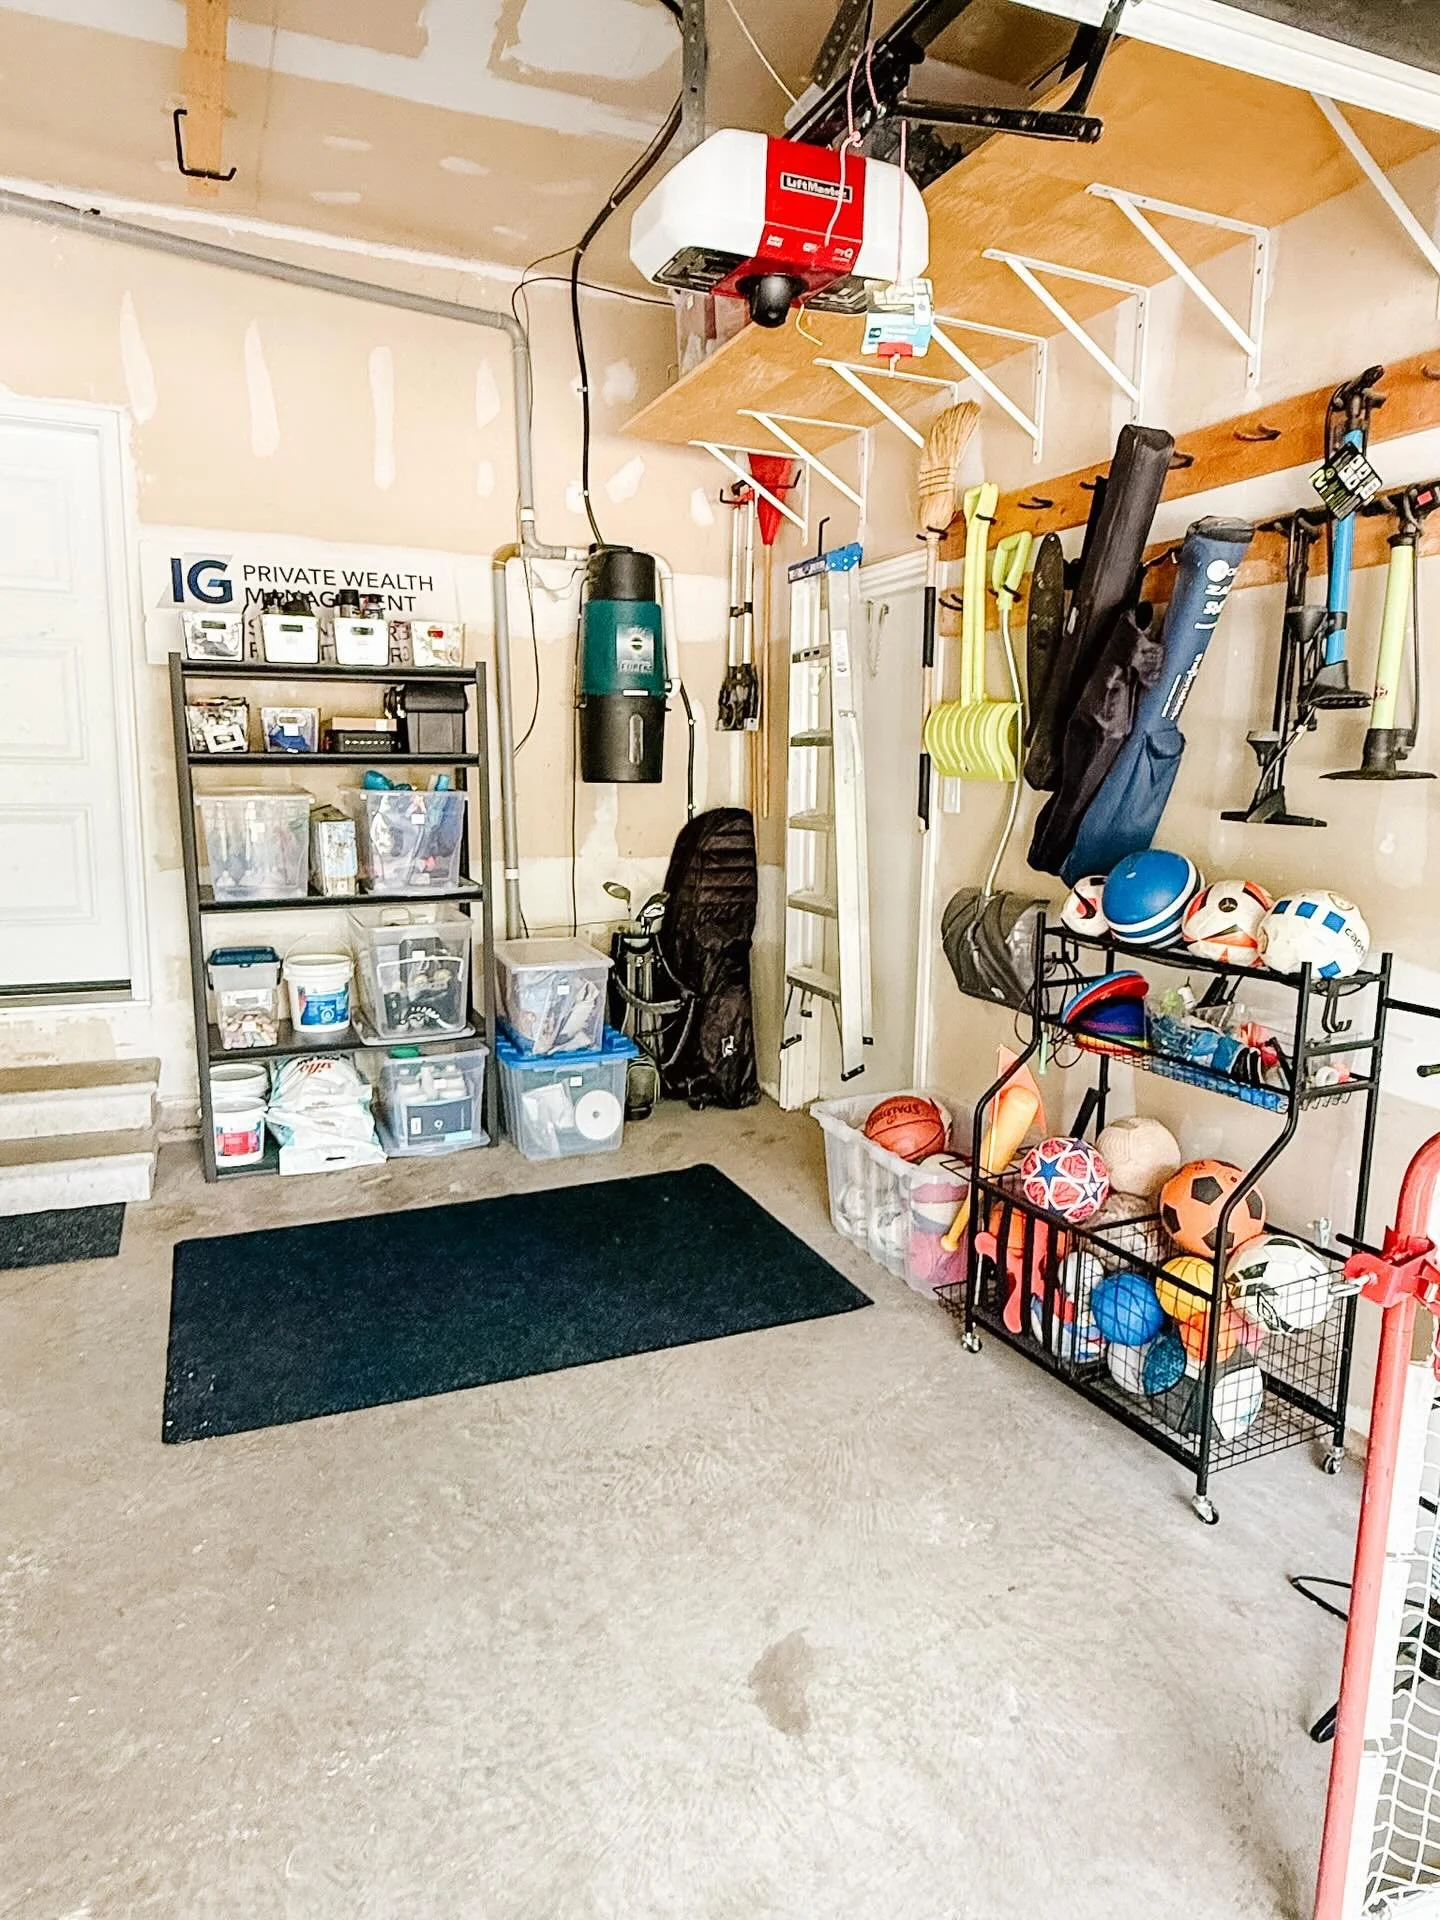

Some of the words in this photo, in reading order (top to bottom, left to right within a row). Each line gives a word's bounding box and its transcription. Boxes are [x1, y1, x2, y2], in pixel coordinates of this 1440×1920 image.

[170, 557, 234, 605] IG
[243, 564, 338, 587] PRIVATE
[342, 569, 434, 592] WEALTH
